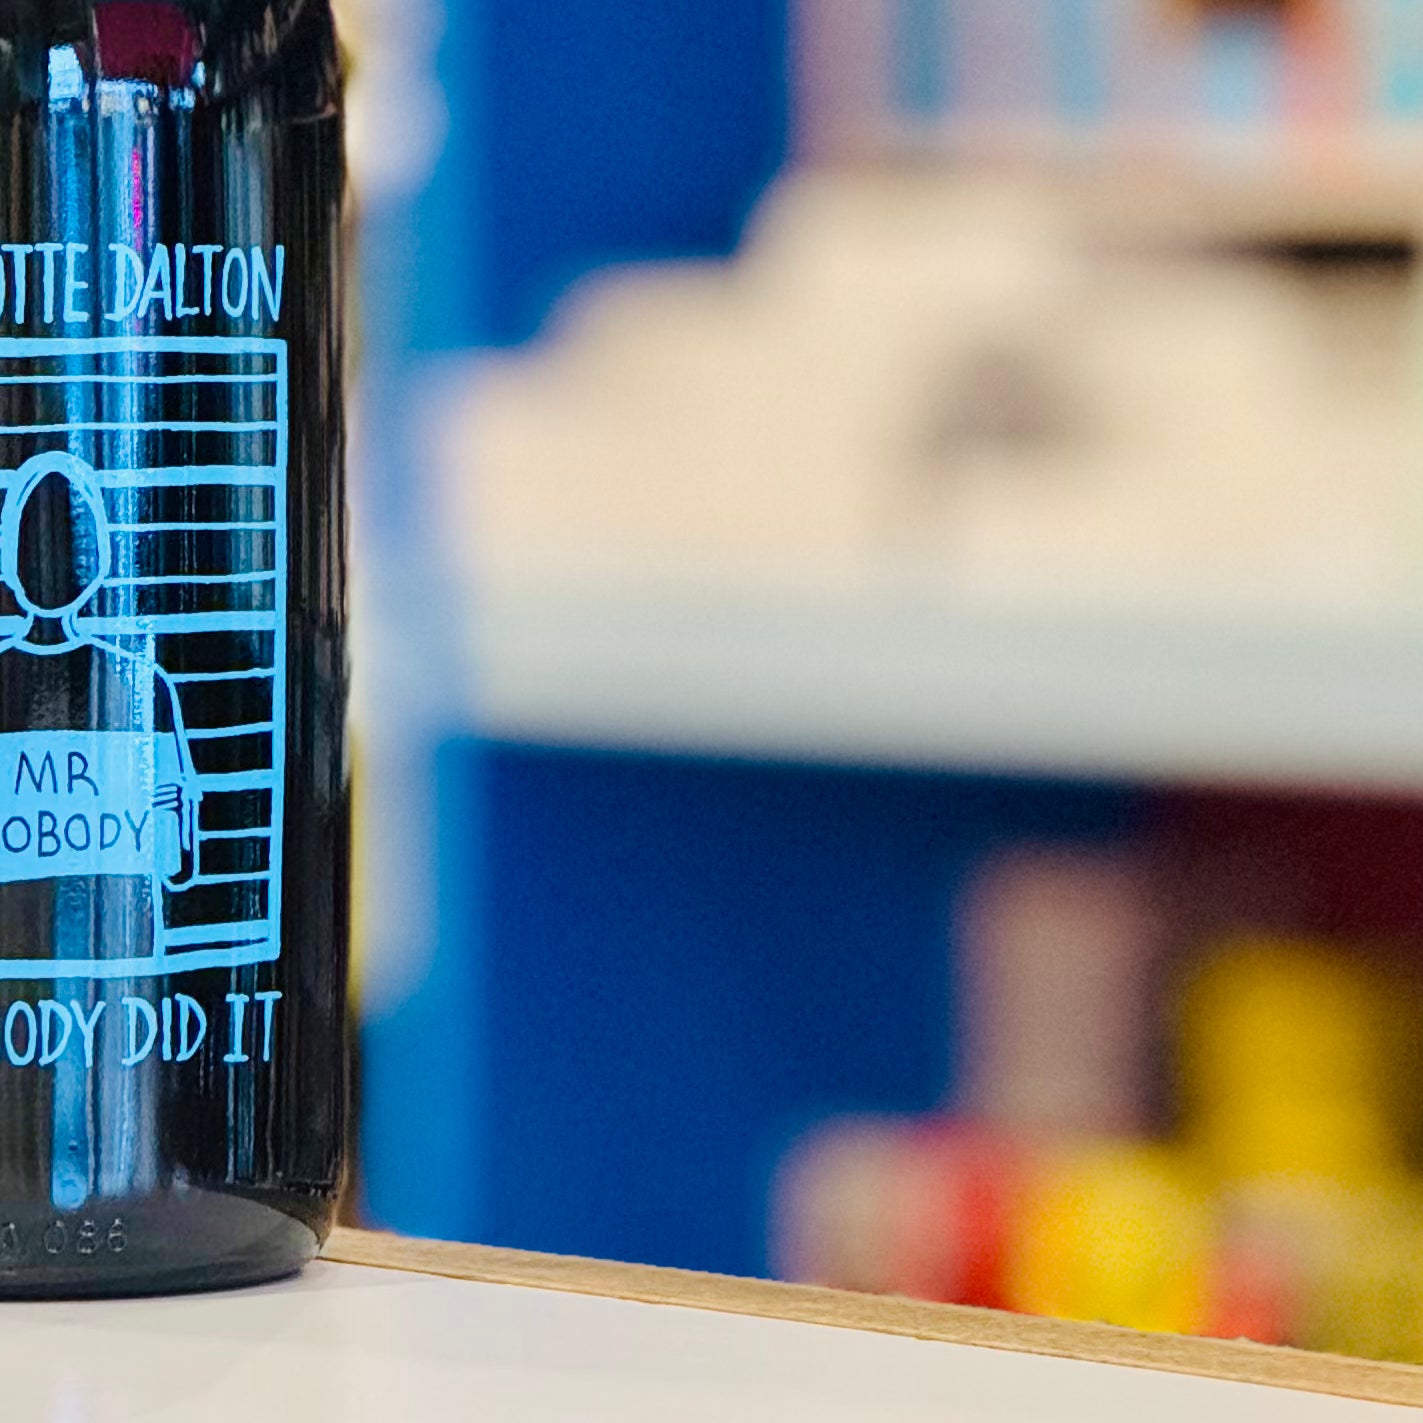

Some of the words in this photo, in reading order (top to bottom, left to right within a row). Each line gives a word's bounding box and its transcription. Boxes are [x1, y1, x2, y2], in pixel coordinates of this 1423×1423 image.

[104, 242, 285, 322] DALTON
[14, 750, 99, 796] MR
[121, 993, 208, 1066] DID
[224, 990, 283, 1063] IT
